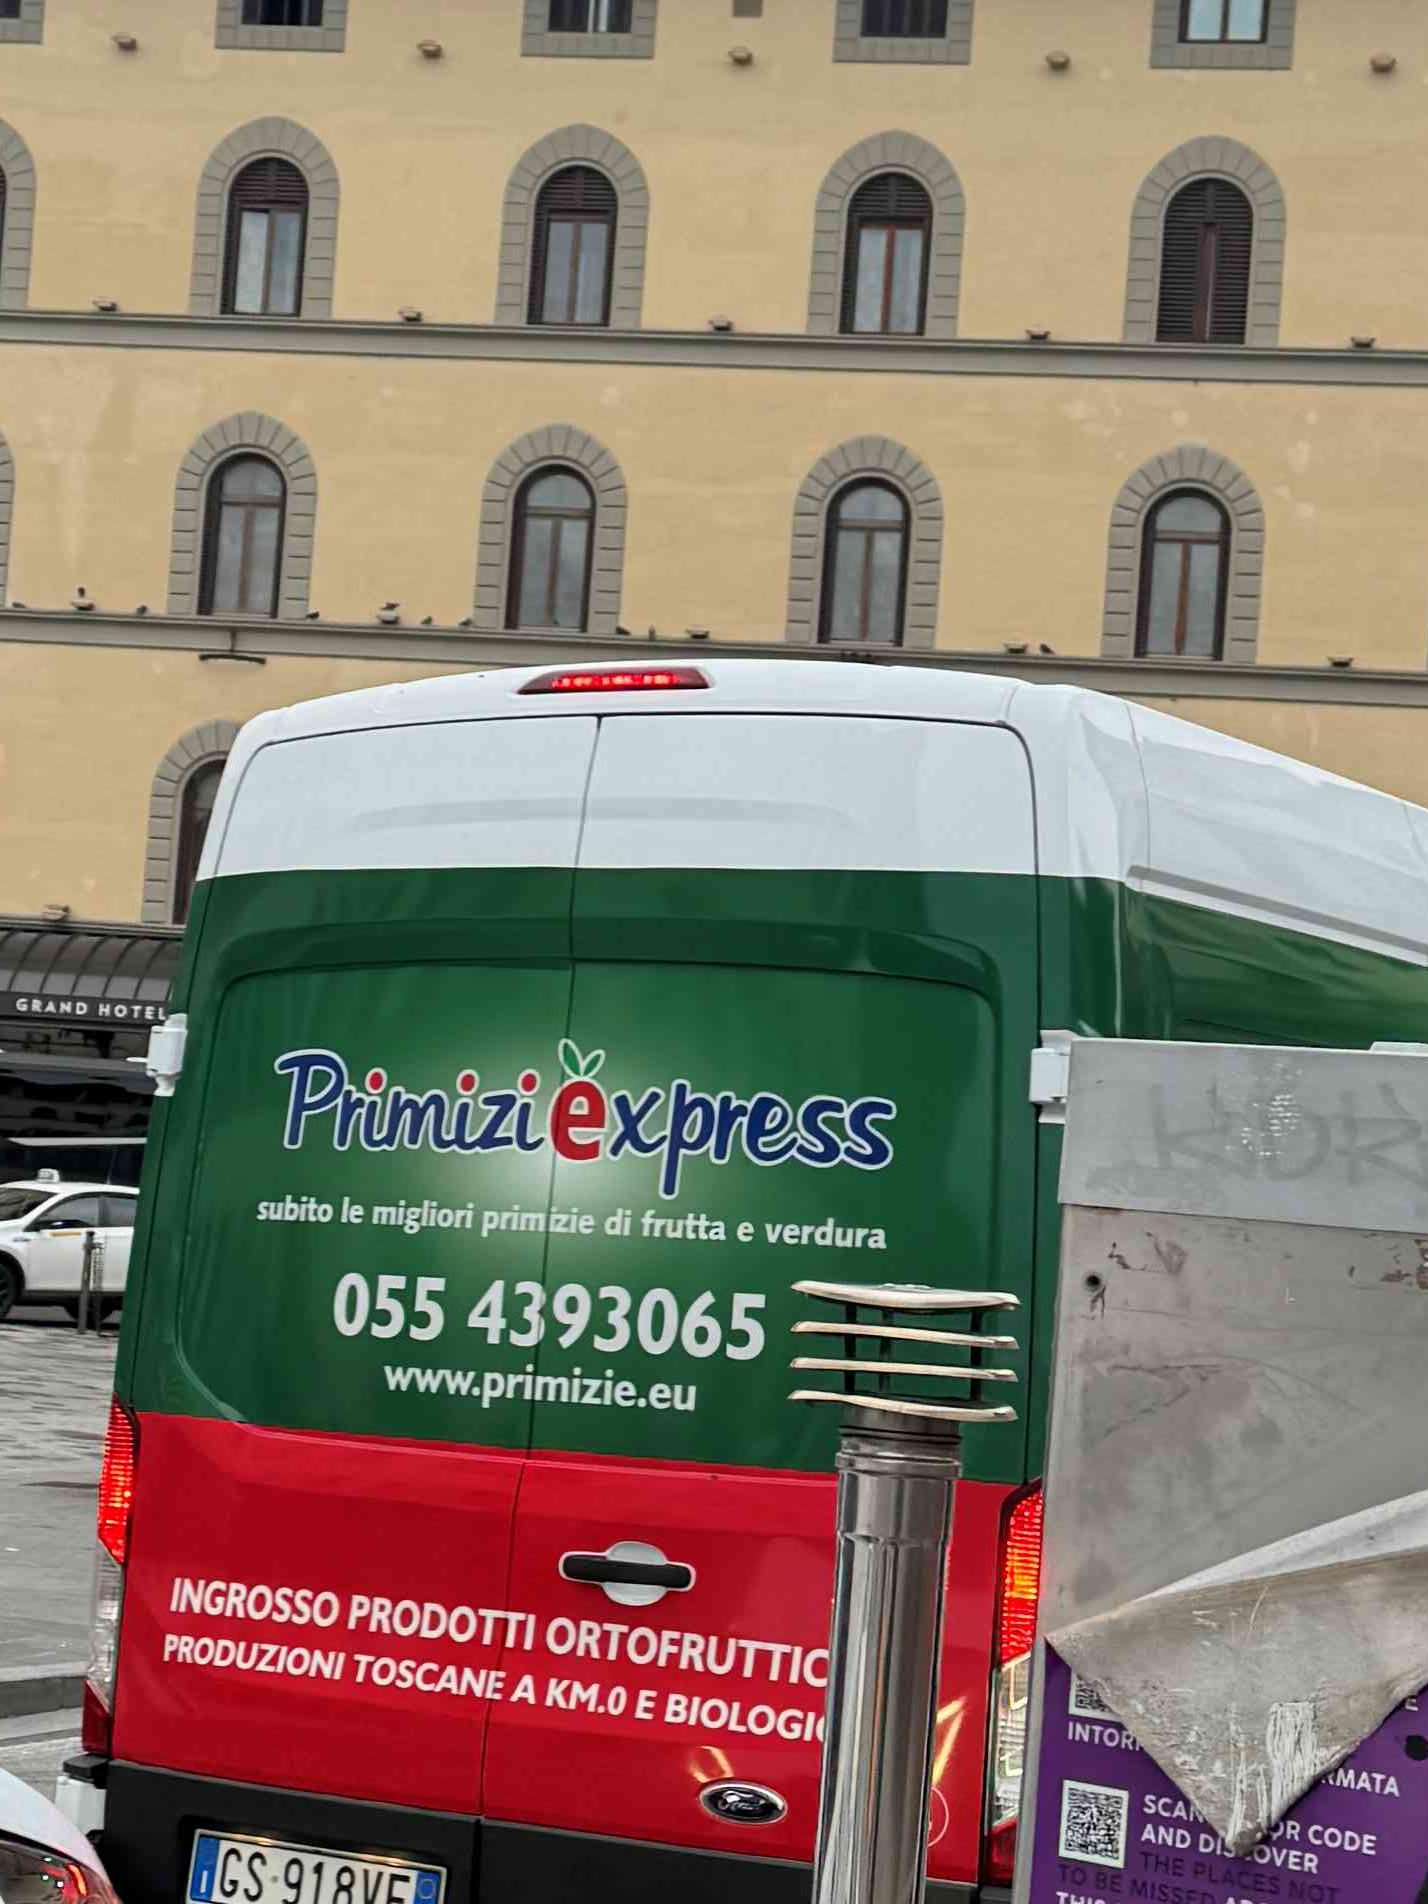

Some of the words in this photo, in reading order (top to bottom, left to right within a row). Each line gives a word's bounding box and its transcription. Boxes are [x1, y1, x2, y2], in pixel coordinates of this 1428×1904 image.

[16, 998, 87, 1015] GRAND
[98, 1001, 167, 1020] HOTEL
[257, 1196, 334, 1223] subito
[340, 1199, 364, 1224] le
[372, 1200, 474, 1234] migliori
[481, 1204, 595, 1237] primizie
[604, 1208, 632, 1237] di
[641, 1209, 727, 1241] frutta
[737, 1220, 755, 1242] e
[764, 1218, 887, 1249] verdura
[333, 1272, 447, 1340] 055
[467, 1279, 767, 1360] 4393065
[383, 1363, 698, 1411] www.primizie.eu
[169, 1577, 340, 1628] INGROSSO
[347, 1594, 536, 1651] PRODOTTI
[163, 1634, 346, 1680] PRODUZIONI
[353, 1653, 507, 1701] TOSCANE
[508, 1674, 537, 1705] A
[544, 1678, 627, 1716] KM.0
[634, 1690, 657, 1721] E
[1140, 1823, 1191, 1850] AND
[1198, 1835, 1319, 1876] DISOVER
[1308, 1825, 1378, 1856] CODE
[220, 1847, 267, 1903] GS
[1057, 1865, 1088, 1888] TO
[1094, 1870, 1122, 1894] BE
[1140, 1853, 1185, 1878] THE
[1192, 1860, 1281, 1896] PLACES
